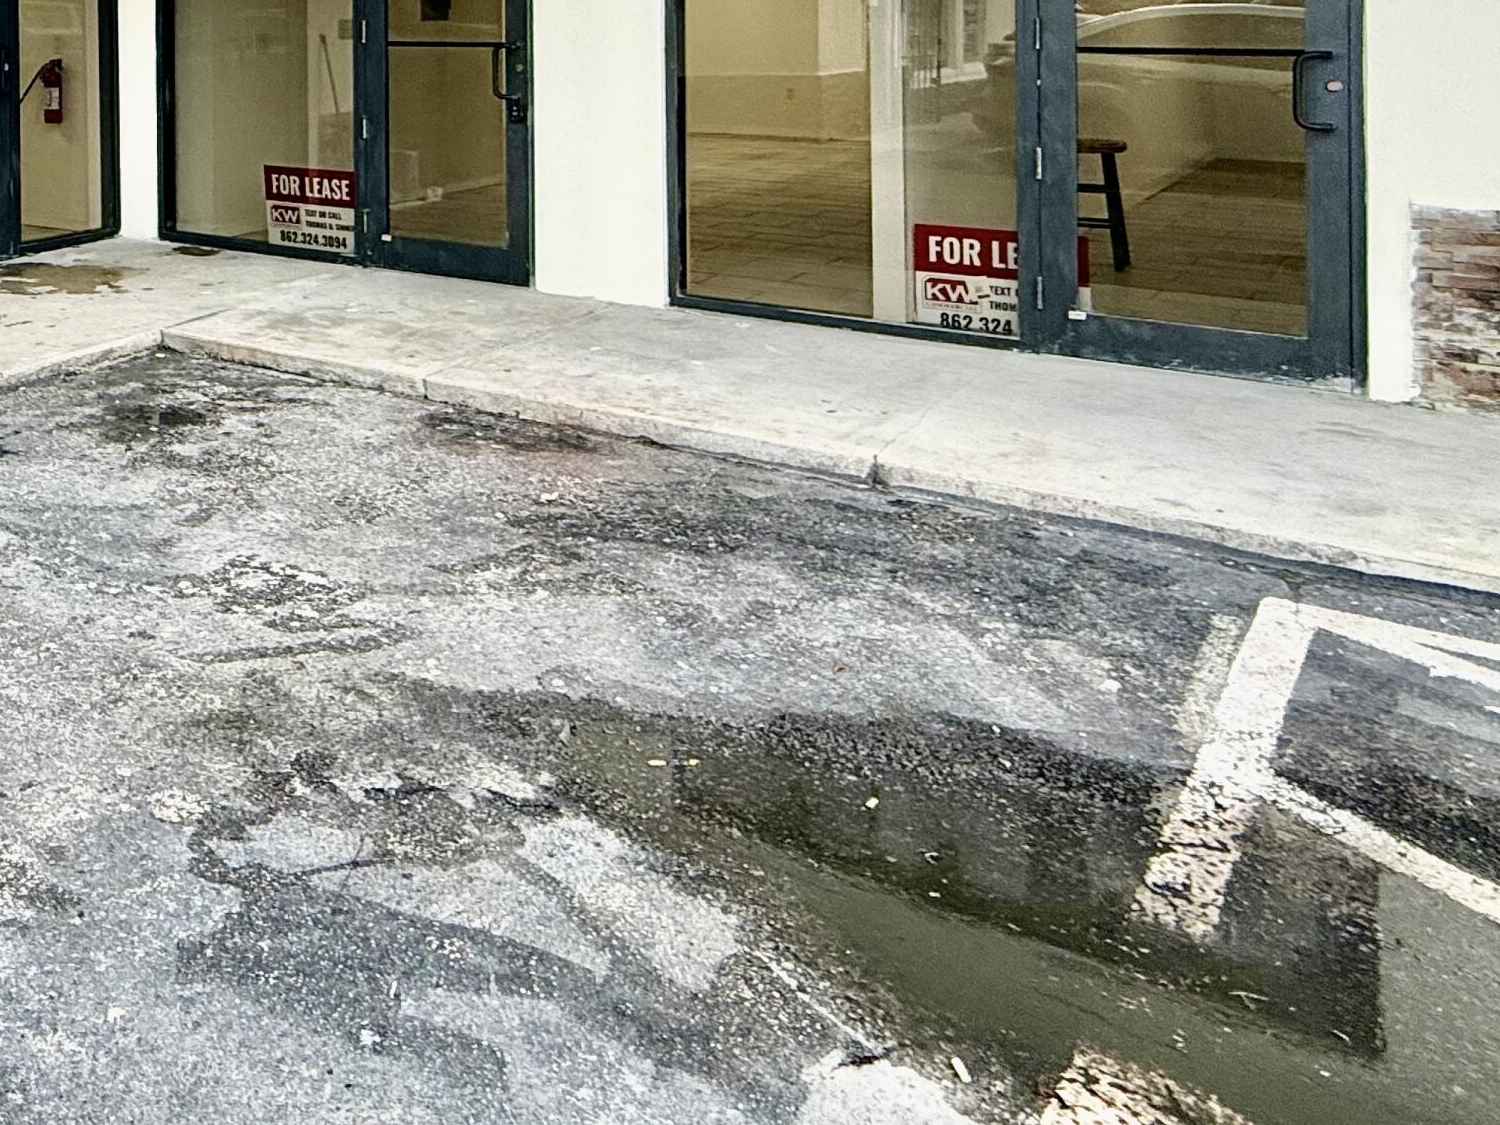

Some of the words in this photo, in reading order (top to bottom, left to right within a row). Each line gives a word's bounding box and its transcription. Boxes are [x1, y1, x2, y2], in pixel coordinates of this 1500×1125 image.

[271, 173, 300, 196] FOR
[304, 176, 351, 201] LEASE
[271, 208, 299, 223] KW
[280, 229, 347, 250] 862.324.3094
[928, 235, 982, 267] FOR
[989, 284, 1012, 296] TEXT
[988, 300, 1018, 312] THOM
